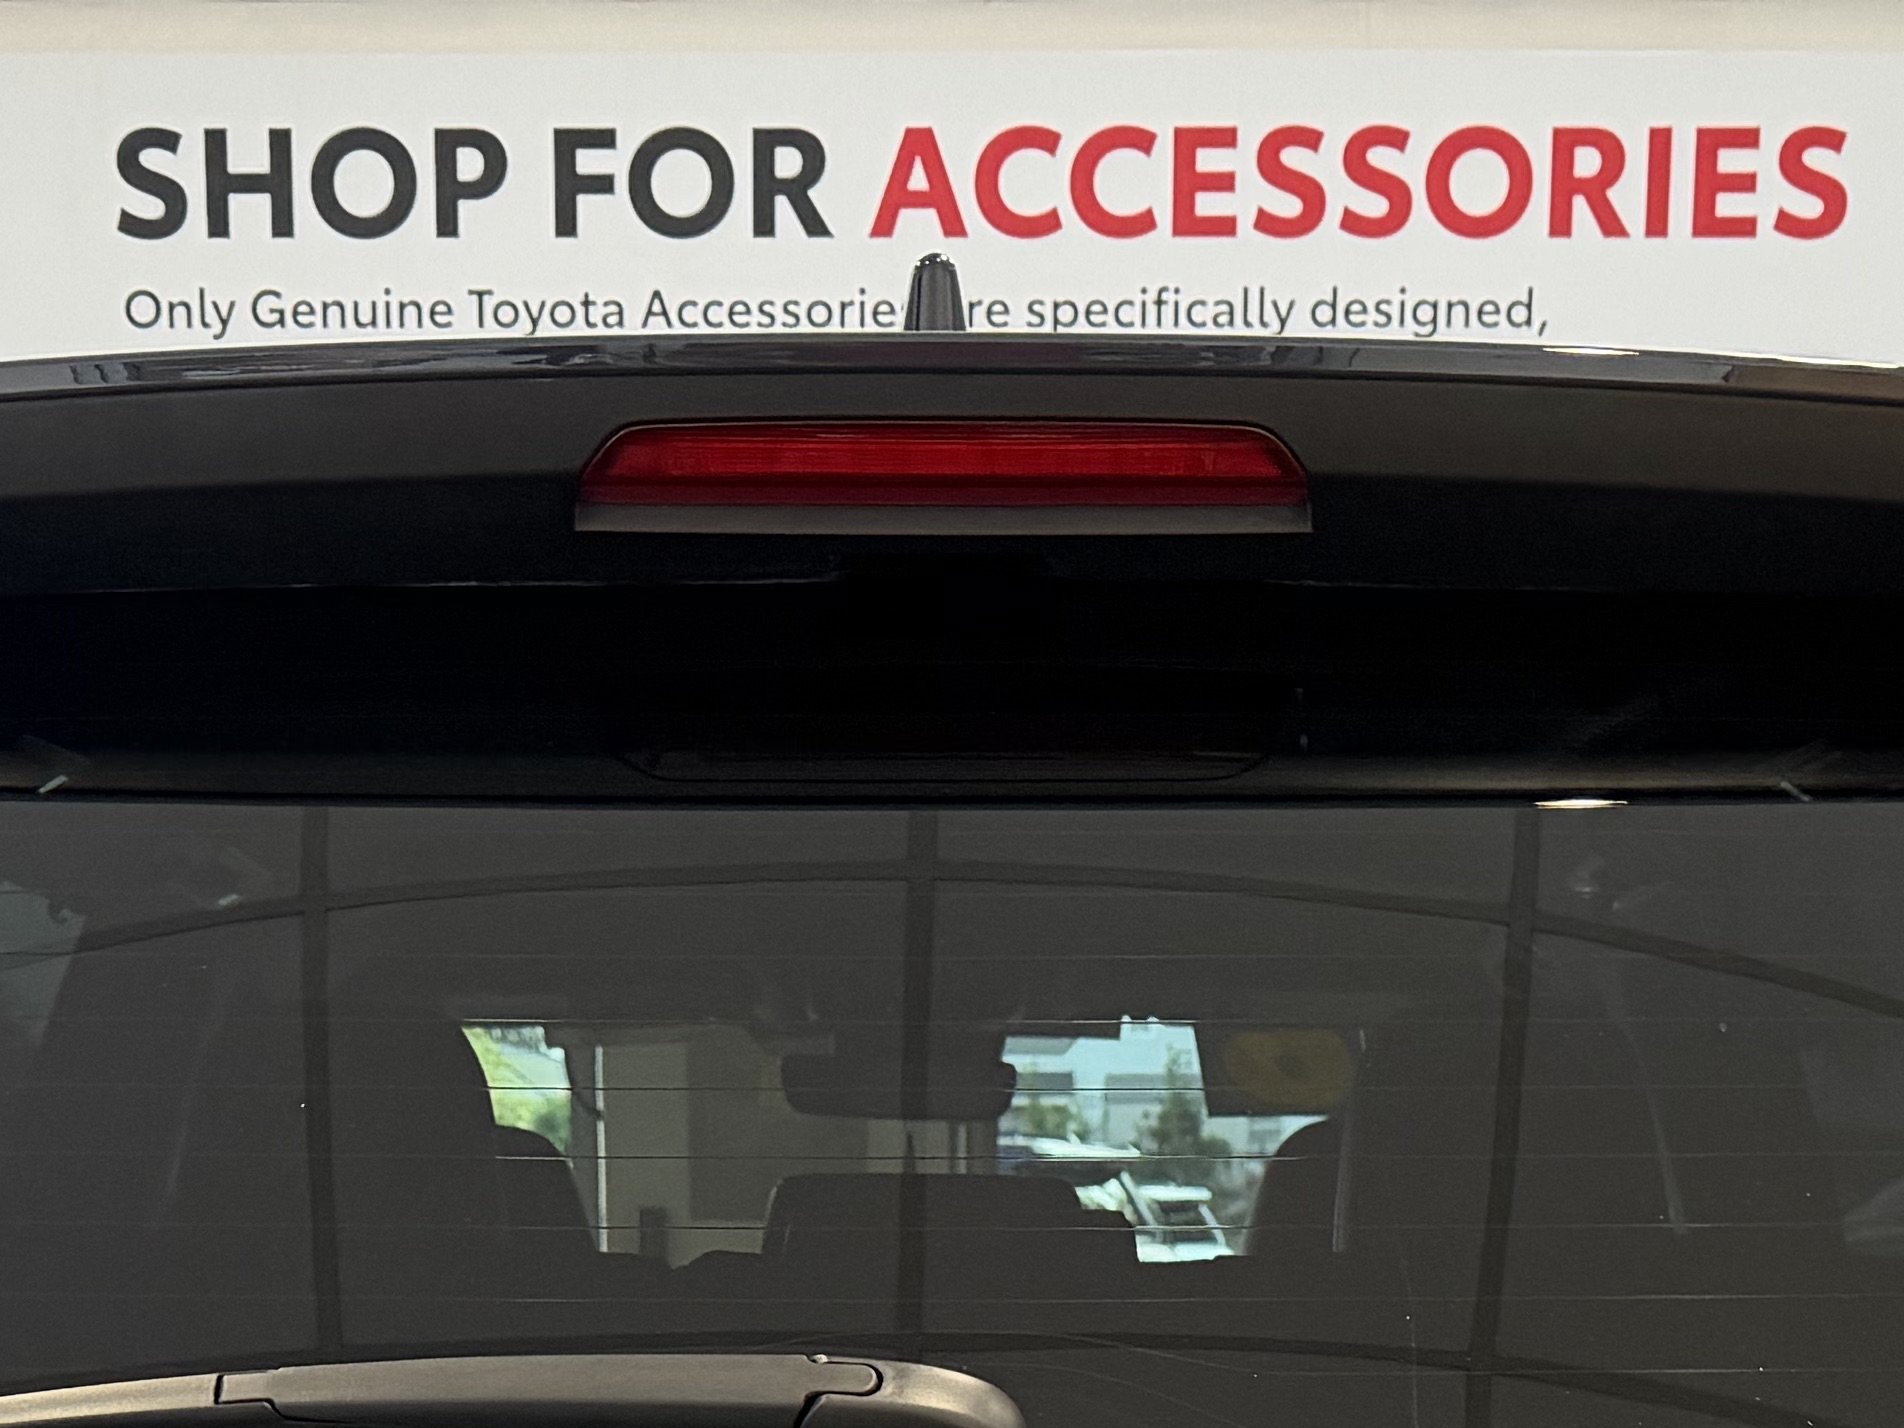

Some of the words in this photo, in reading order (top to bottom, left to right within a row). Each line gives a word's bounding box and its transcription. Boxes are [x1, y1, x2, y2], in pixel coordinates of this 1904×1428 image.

[116, 126, 508, 239] SHOP
[552, 126, 835, 239] FOR
[869, 125, 1849, 240] ACCESSORIES
[124, 288, 235, 339] Only
[252, 289, 454, 330] Genuine
[468, 289, 626, 336] Toyota
[642, 286, 902, 329] Accessorie
[966, 299, 1011, 329] re
[1025, 286, 1295, 335] specifically
[1309, 286, 1550, 335] designed,
